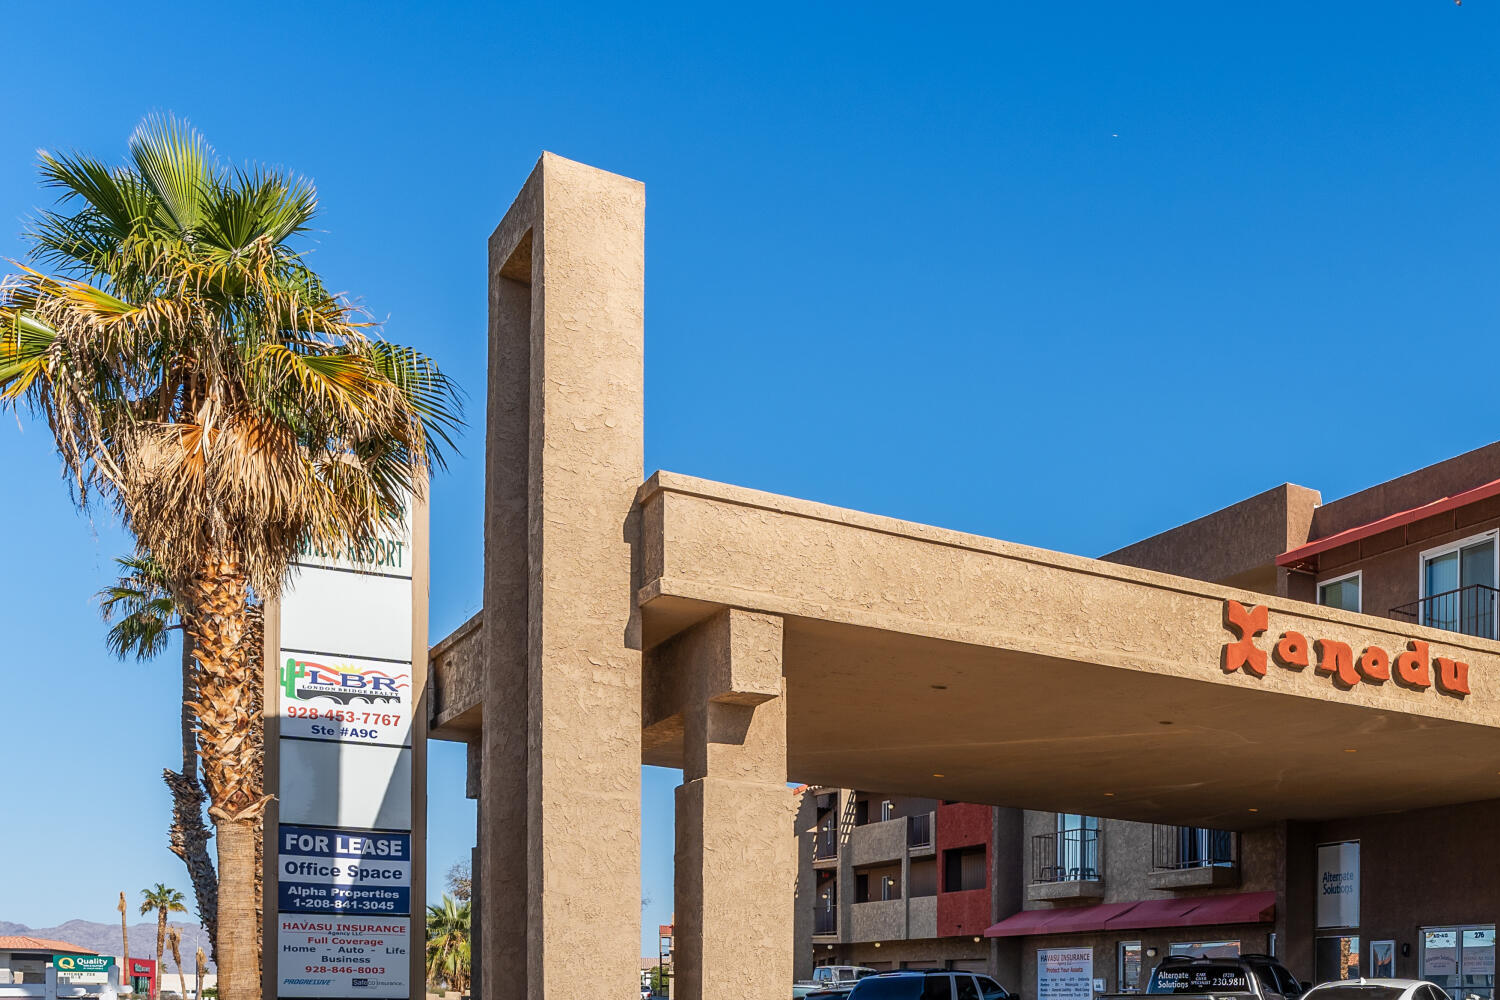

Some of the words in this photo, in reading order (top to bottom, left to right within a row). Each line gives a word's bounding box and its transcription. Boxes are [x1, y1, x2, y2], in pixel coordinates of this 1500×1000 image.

[1220, 600, 1471, 699] Xanadu
[309, 670, 399, 692] LBR
[287, 706, 401, 727] 928-453-7767
[311, 724, 335, 736] Ste
[340, 727, 378, 739] #A9C
[285, 833, 329, 853] FOR
[336, 836, 402, 856] LEASE
[285, 861, 341, 877] Office
[347, 864, 403, 881] Space
[1322, 871, 1354, 882] Alternate
[288, 886, 326, 898] Alpha
[331, 888, 399, 899] Properties
[1323, 883, 1353, 895] Solutions
[293, 898, 395, 910] 1-208-841-3045
[282, 922, 332, 931] HAVASU
[336, 923, 406, 933] INSURANCE
[1474, 931, 1485, 939] 276
[307, 936, 328, 944] Full
[331, 937, 384, 946] Coverage
[283, 944, 316, 953] Home
[338, 946, 364, 954] Auto
[385, 947, 406, 955] Life
[58, 957, 76, 970] Q
[76, 957, 108, 967] Quality
[321, 955, 371, 963] Business
[305, 965, 385, 974] 928-846-8003
[1158, 971, 1189, 980] Alternate
[1157, 980, 1189, 989] Solutions
[1212, 978, 1245, 986] 230.9811
